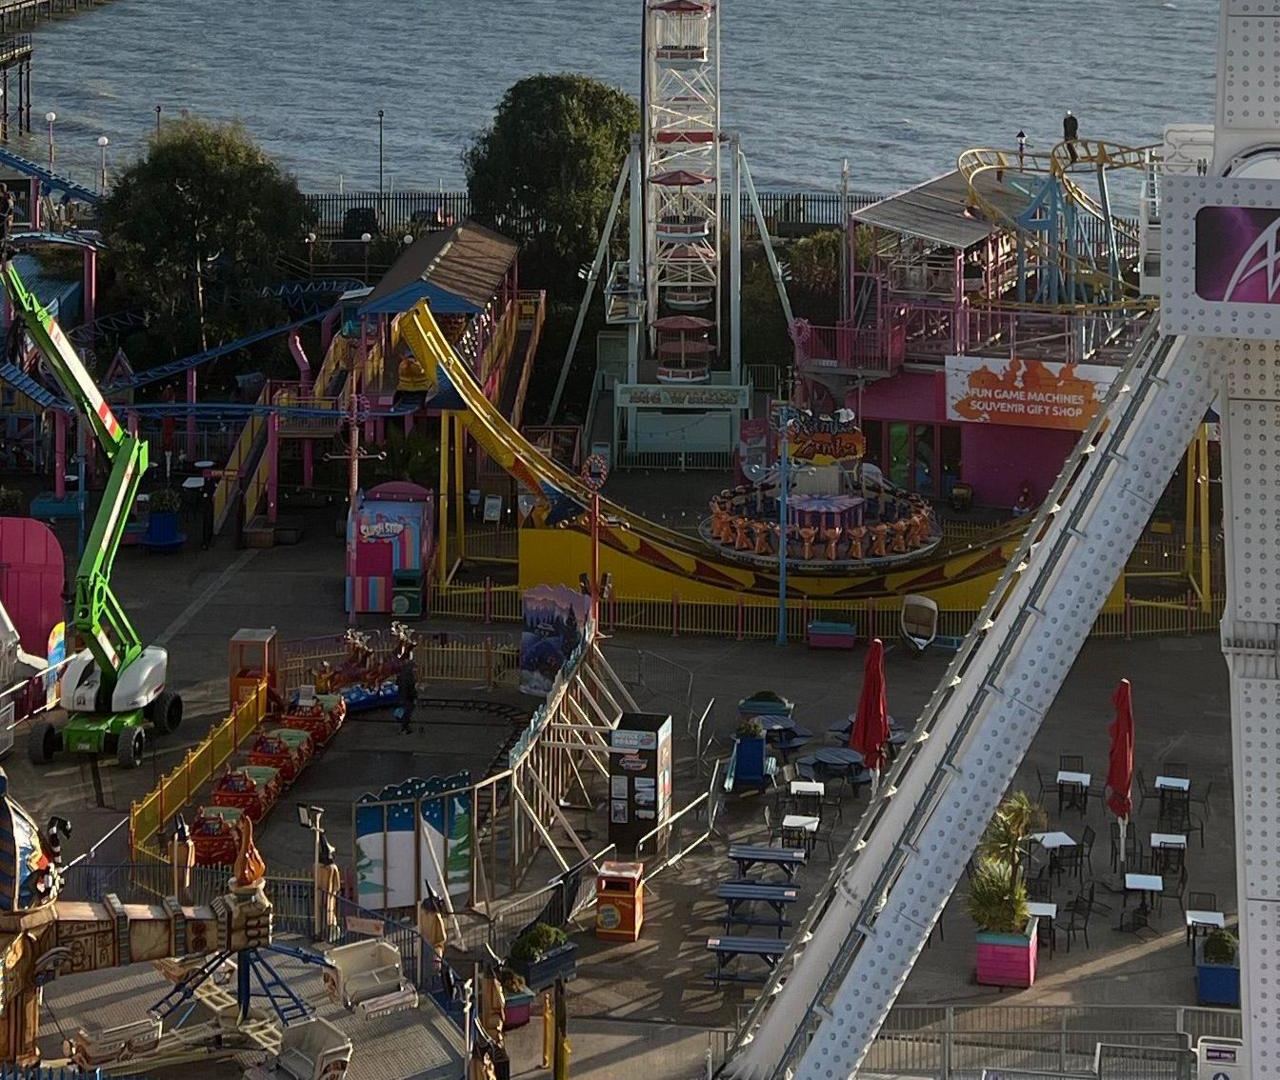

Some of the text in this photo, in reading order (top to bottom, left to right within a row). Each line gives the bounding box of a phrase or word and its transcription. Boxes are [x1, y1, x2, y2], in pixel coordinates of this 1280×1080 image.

[970, 387, 1084, 405] FUN GAME MACHINES
[970, 400, 1083, 418] SOUVENIR GIFT SHOP
